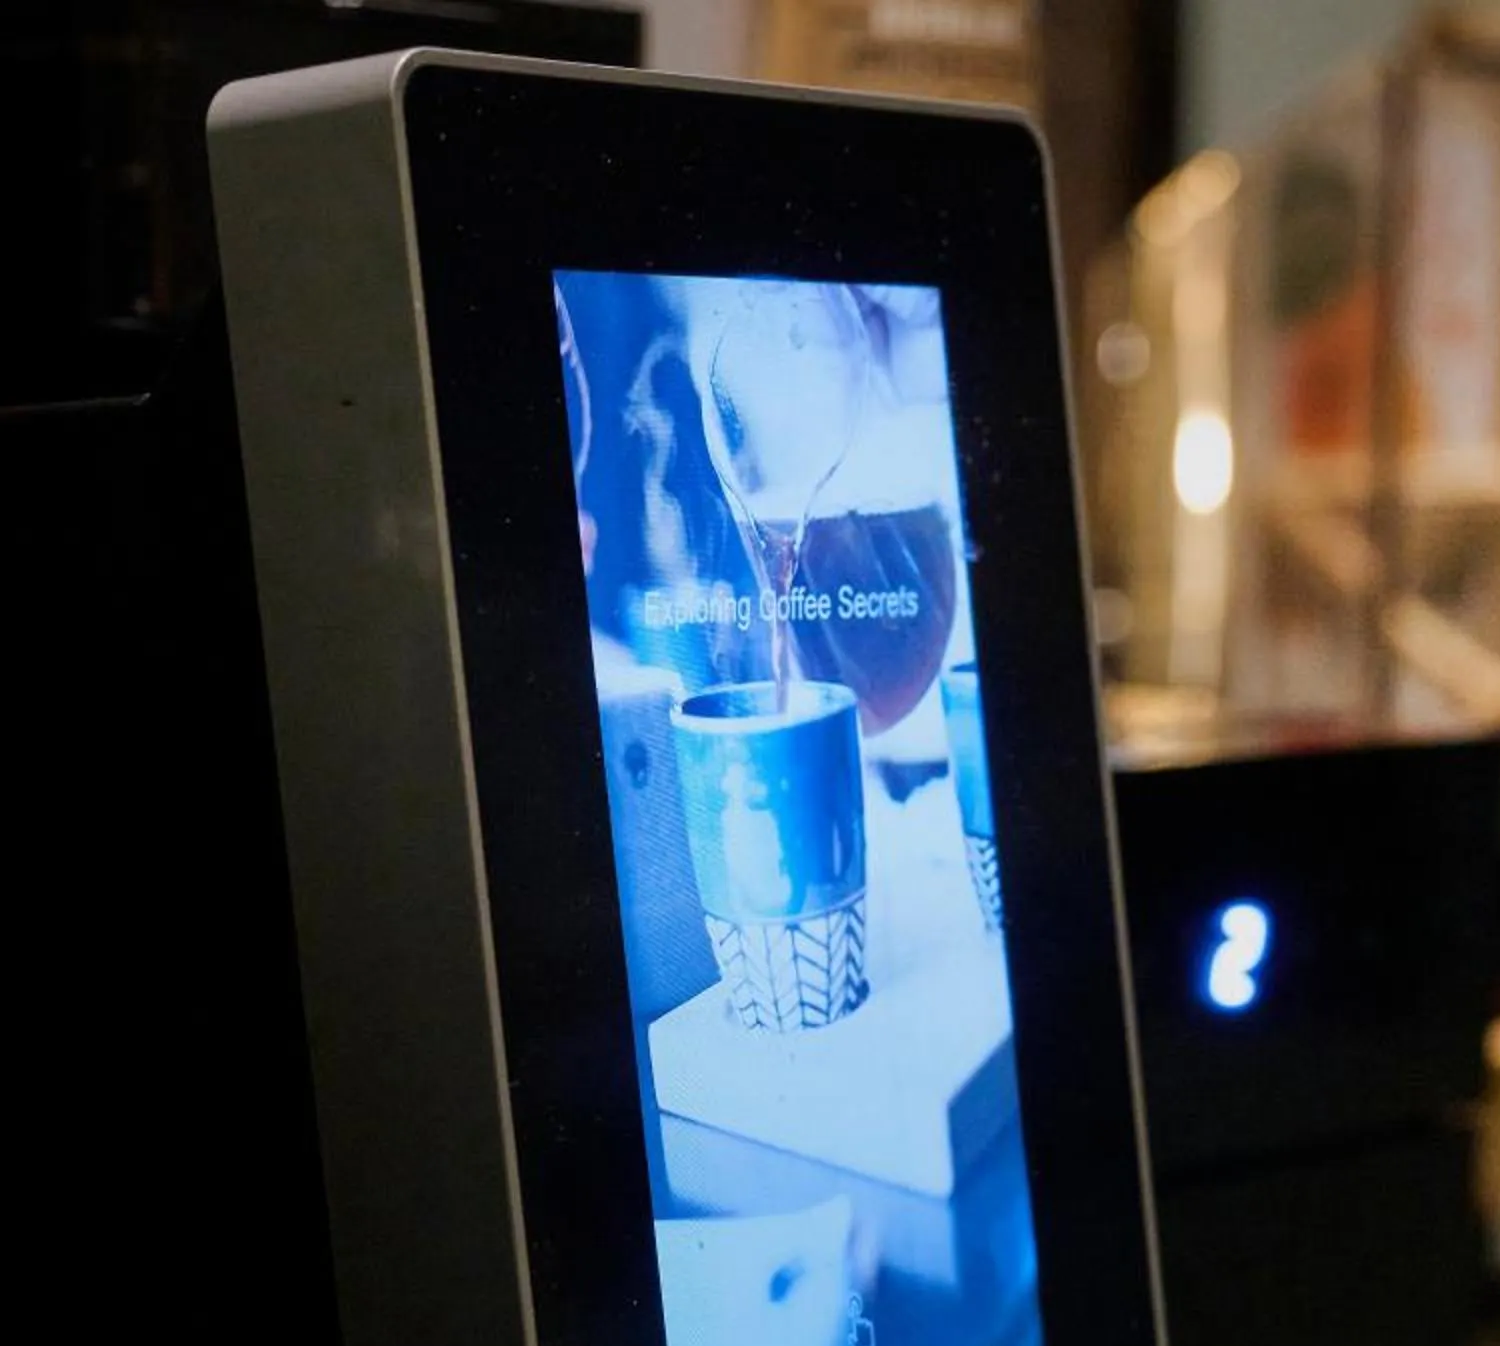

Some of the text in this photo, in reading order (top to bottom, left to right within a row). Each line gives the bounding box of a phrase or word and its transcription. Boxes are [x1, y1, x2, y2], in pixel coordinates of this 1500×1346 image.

[644, 584, 919, 630] Exploring Coffee Secrets
